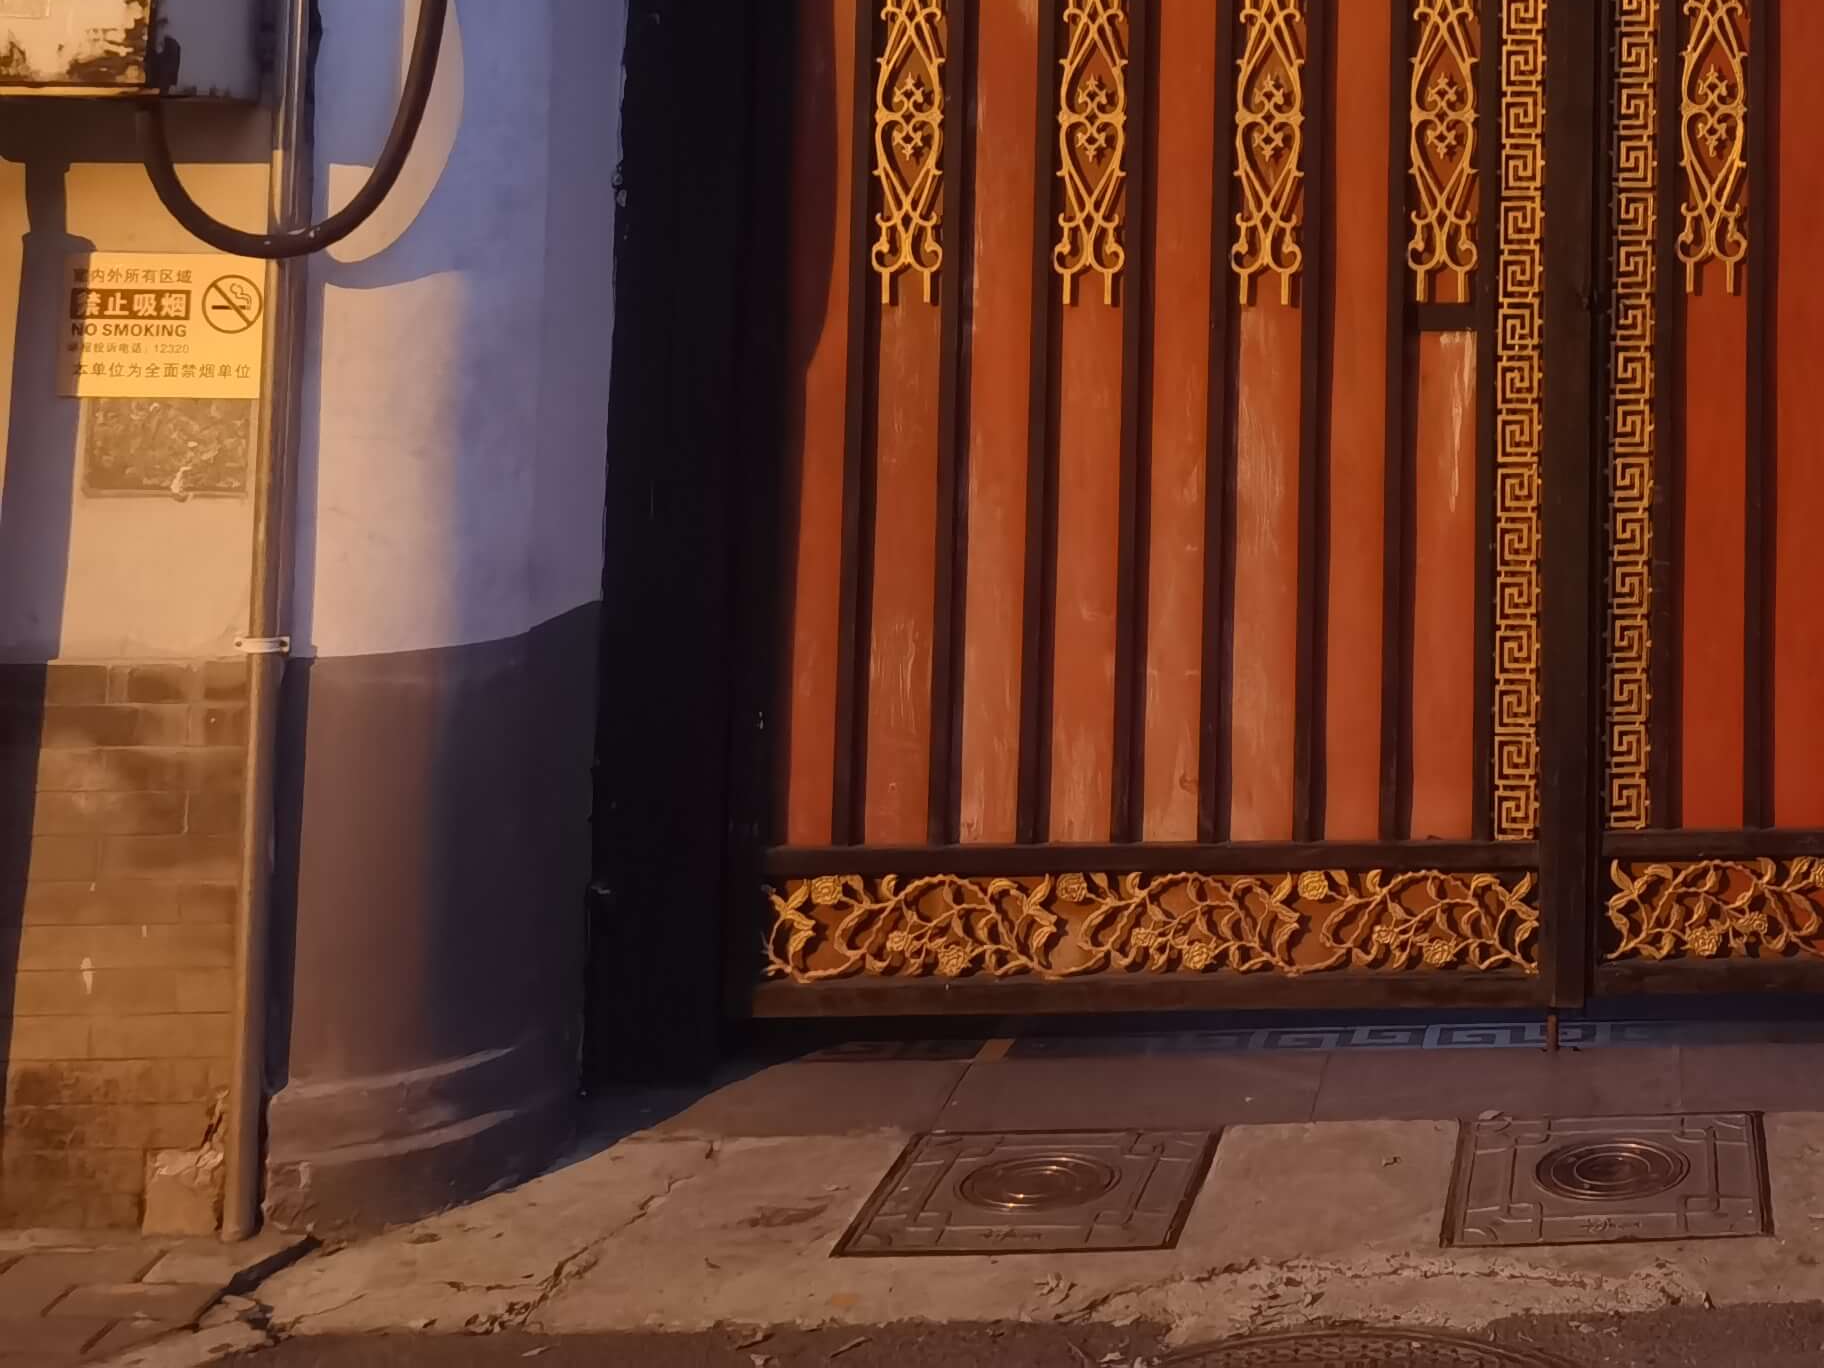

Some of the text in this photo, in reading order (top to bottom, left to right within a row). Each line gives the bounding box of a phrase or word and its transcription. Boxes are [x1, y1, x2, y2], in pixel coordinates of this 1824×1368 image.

[75, 291, 187, 318] 禁止吸烟
[71, 322, 187, 338] NO SMOKING
[73, 362, 251, 379] 本单位为全面禁烟单位
